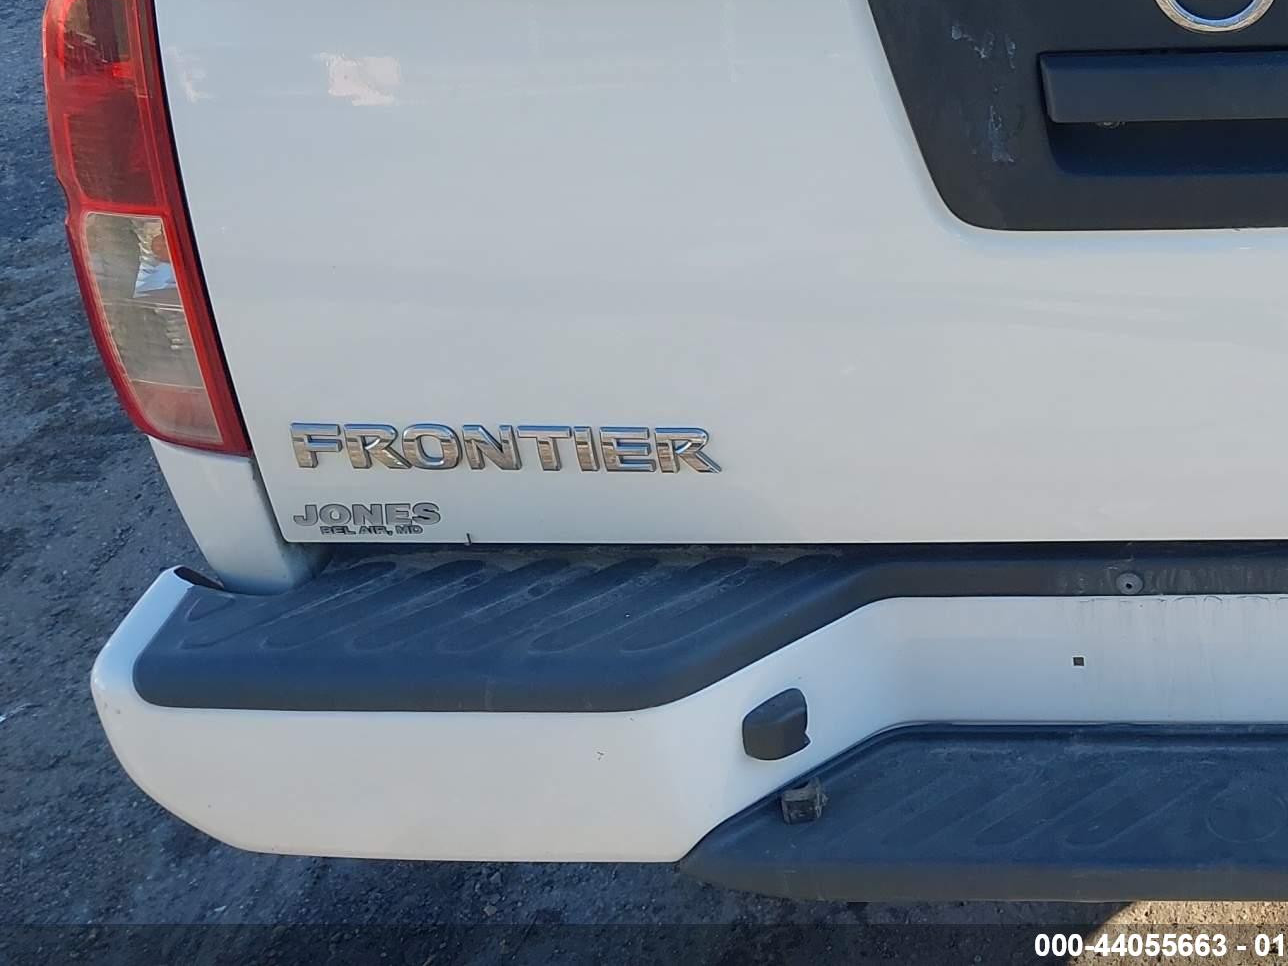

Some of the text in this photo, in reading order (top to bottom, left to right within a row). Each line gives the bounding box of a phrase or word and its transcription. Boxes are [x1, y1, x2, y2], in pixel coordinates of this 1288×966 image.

[290, 422, 722, 474] FRONTIER
[293, 502, 442, 526] JONES
[320, 525, 356, 535] BEL
[395, 524, 423, 535] MD
